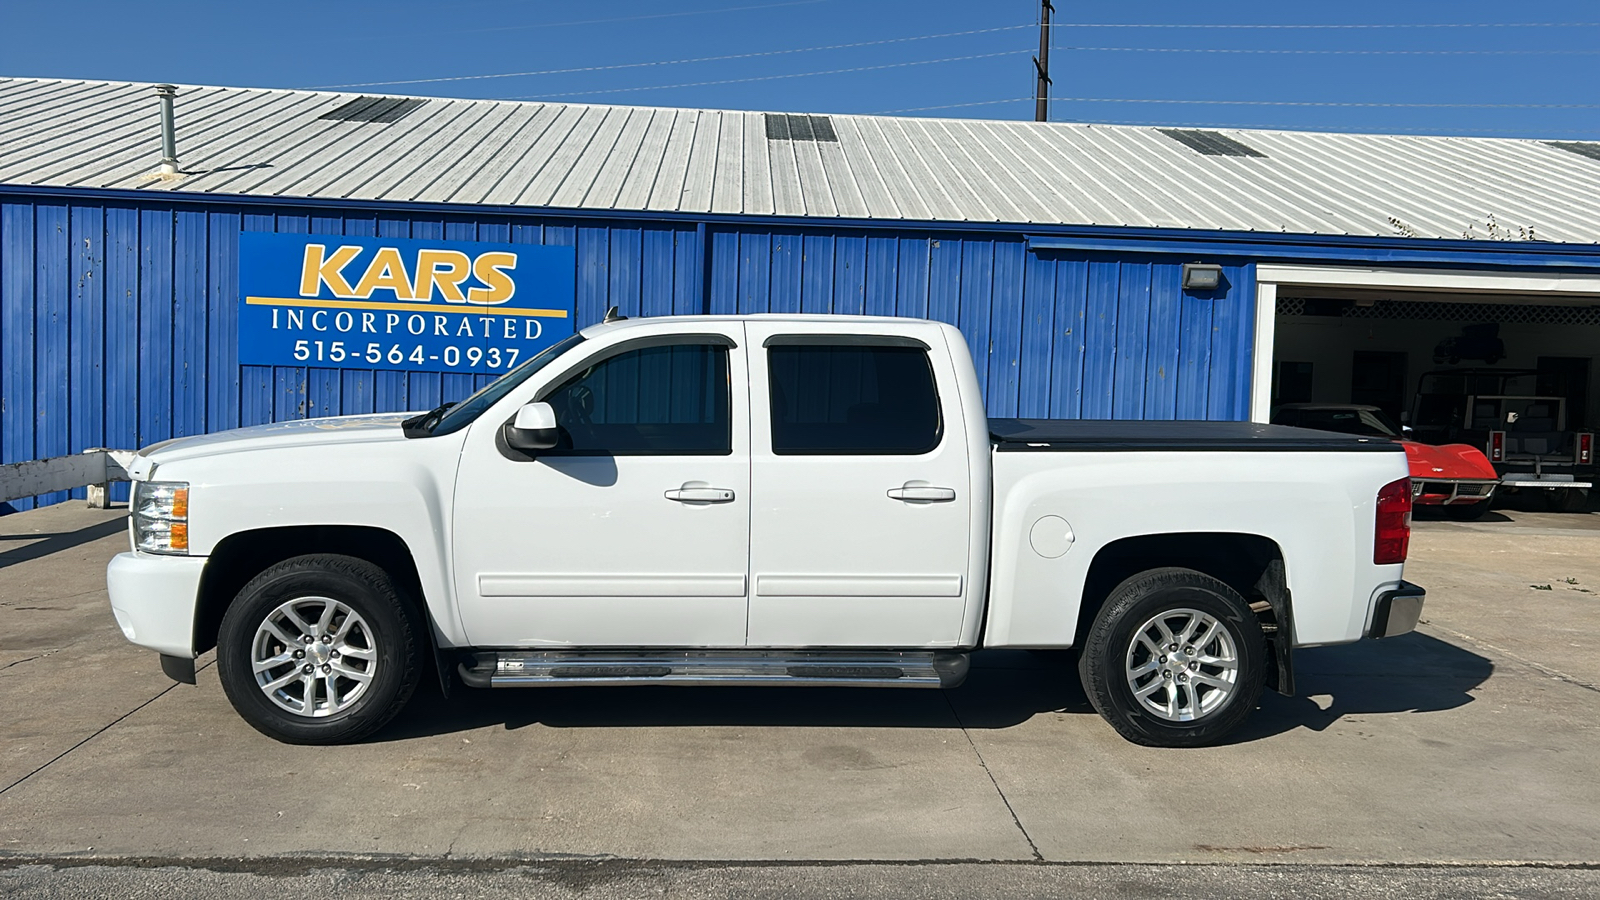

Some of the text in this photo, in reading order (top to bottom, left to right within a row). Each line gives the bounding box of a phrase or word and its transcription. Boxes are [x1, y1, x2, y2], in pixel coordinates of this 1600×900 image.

[299, 243, 518, 305] KARS
[271, 309, 543, 340] INCORPORATED
[293, 340, 520, 369] 515-564-0937
